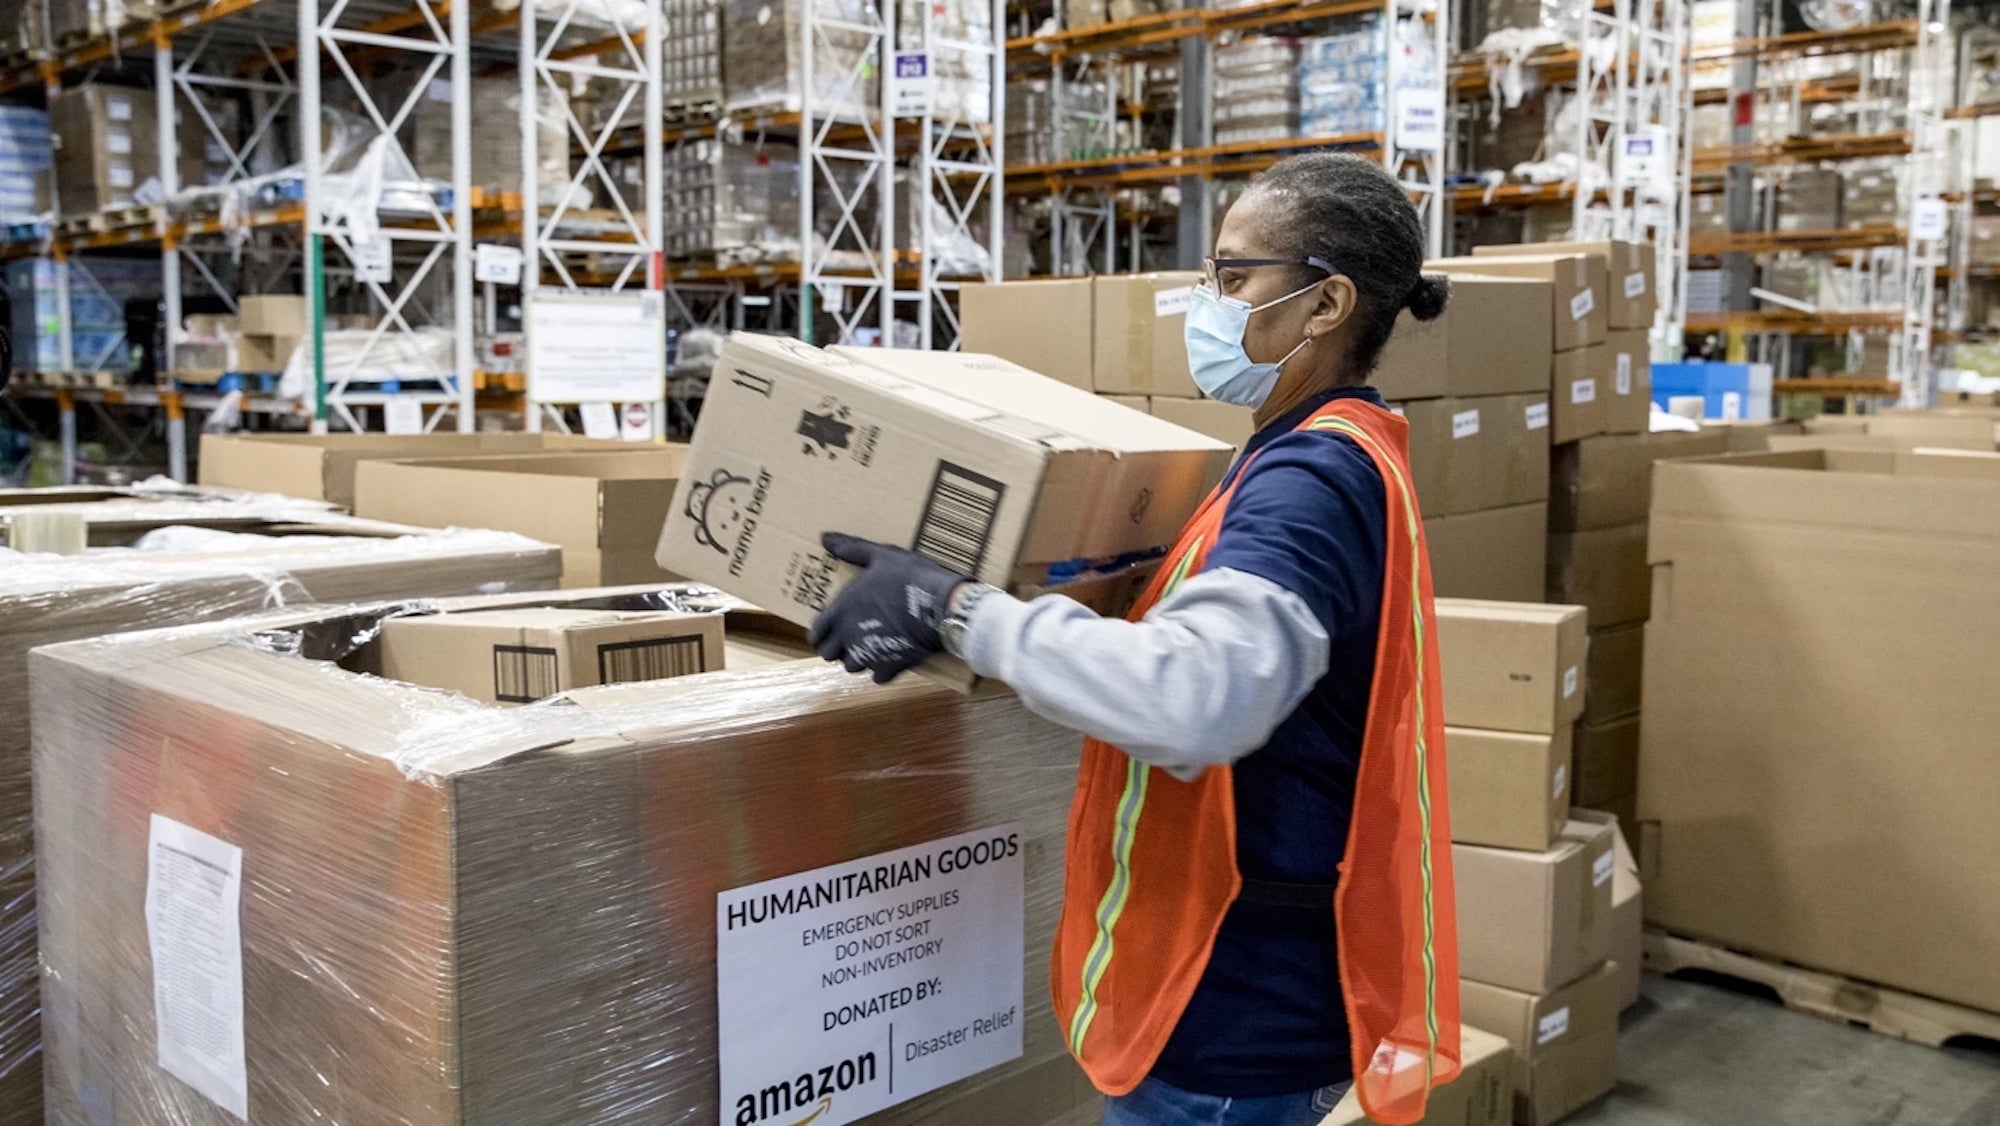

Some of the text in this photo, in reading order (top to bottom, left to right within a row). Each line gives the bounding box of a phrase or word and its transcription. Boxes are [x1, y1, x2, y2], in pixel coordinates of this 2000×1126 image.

[728, 466, 773, 578] mama bear
[793, 565, 818, 605] SIZE
[810, 550, 841, 612] DIAPE
[727, 832, 1019, 931] HUMANITARIAN GOODS
[802, 888, 960, 946] EMERGENCY SUPPLIES
[835, 920, 931, 961] DO NOT SORT
[821, 937, 944, 988] NON-INVENTORY
[823, 976, 942, 1032] DONATED BY:
[905, 1006, 1017, 1063] Disaster Relief
[734, 1050, 877, 1126] amazon
